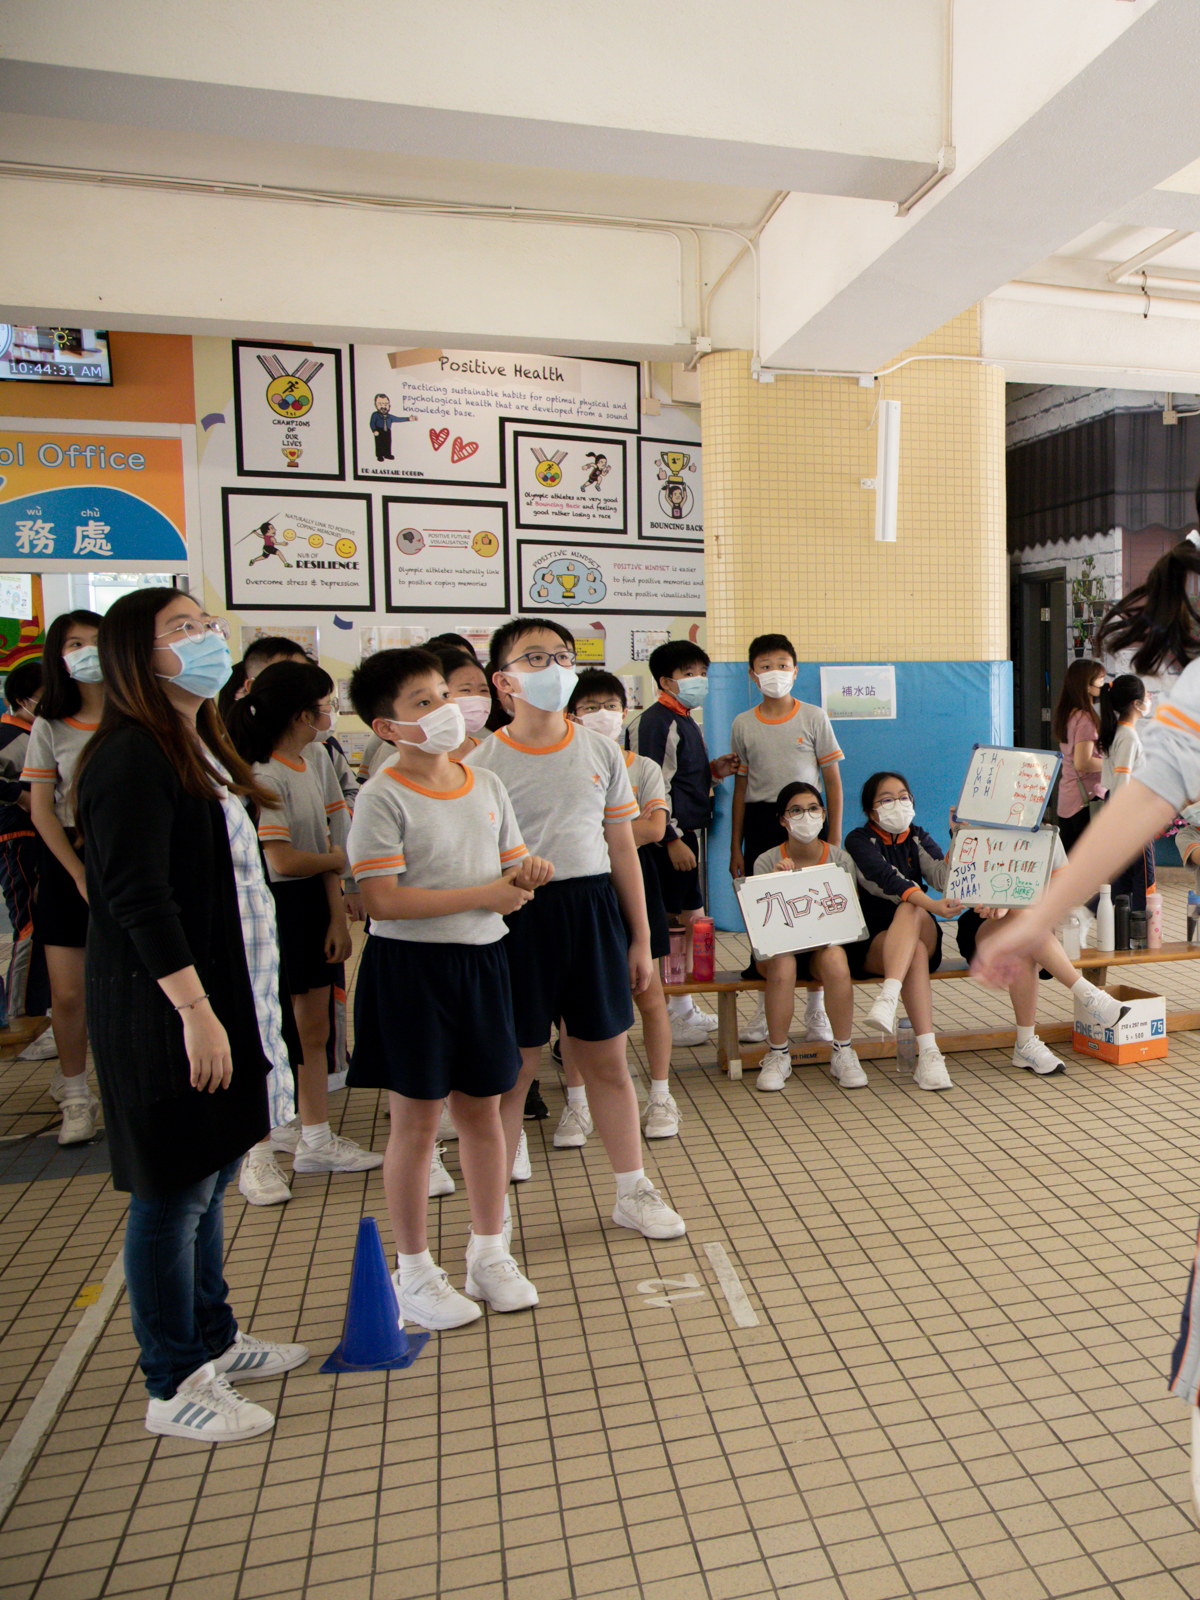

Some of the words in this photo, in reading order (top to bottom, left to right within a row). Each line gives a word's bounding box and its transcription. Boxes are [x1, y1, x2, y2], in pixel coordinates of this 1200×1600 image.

[10, 362, 76, 376] 10:44:31
[81, 366, 102, 377] AM
[439, 356, 507, 377] Positive
[514, 363, 565, 382] Health
[402, 381, 448, 396] Practicing
[451, 386, 499, 398] sustainable
[502, 390, 527, 400] habits
[530, 391, 543, 402] for
[545, 395, 576, 405] optimal
[579, 399, 610, 410] physical
[612, 402, 627, 410] and
[402, 394, 462, 406] psychological
[465, 398, 492, 408] health
[495, 400, 512, 409] that
[532, 403, 574, 418] developed
[576, 407, 595, 417] from
[606, 413, 628, 421] sound
[402, 405, 451, 417] knowledge
[453, 407, 475, 417] base.
[272, 419, 310, 428] CHAMPIONS
[285, 433, 299, 441] OUR
[282, 440, 302, 448] LIVES
[38, 442, 146, 471] Office
[524, 491, 548, 501] Olympic
[550, 493, 575, 501] athletes
[588, 496, 602, 505] very
[535, 500, 564, 510] Bouncing
[596, 504, 618, 513] feeling
[572, 511, 590, 519] losing
[650, 521, 685, 531] BOUNCING
[685, 524, 704, 532] BACK
[15, 519, 114, 556] 務處
[296, 560, 360, 570] RESILIENCE
[532, 550, 568, 569] POSITIVE
[570, 551, 602, 570] MINDSET
[398, 566, 423, 576] Olympic
[455, 568, 485, 577] naturally
[613, 563, 643, 571] POSITIVE
[644, 564, 670, 572] MINDSET
[245, 578, 283, 587] Overcome
[286, 578, 308, 587] stress
[320, 579, 359, 590] Depression
[408, 579, 432, 588] positive
[434, 580, 456, 588] coping
[637, 578, 661, 588] positive
[635, 591, 659, 601] positive
[841, 685, 876, 697] 補水站
[953, 861, 977, 878] JUST
[950, 873, 976, 891] JUMP
[756, 881, 848, 928] 加油
[1075, 1020, 1093, 1038] FINE
[1105, 1028, 1114, 1044] 75
[1151, 1020, 1164, 1034] 75
[636, 1273, 706, 1308] 12
